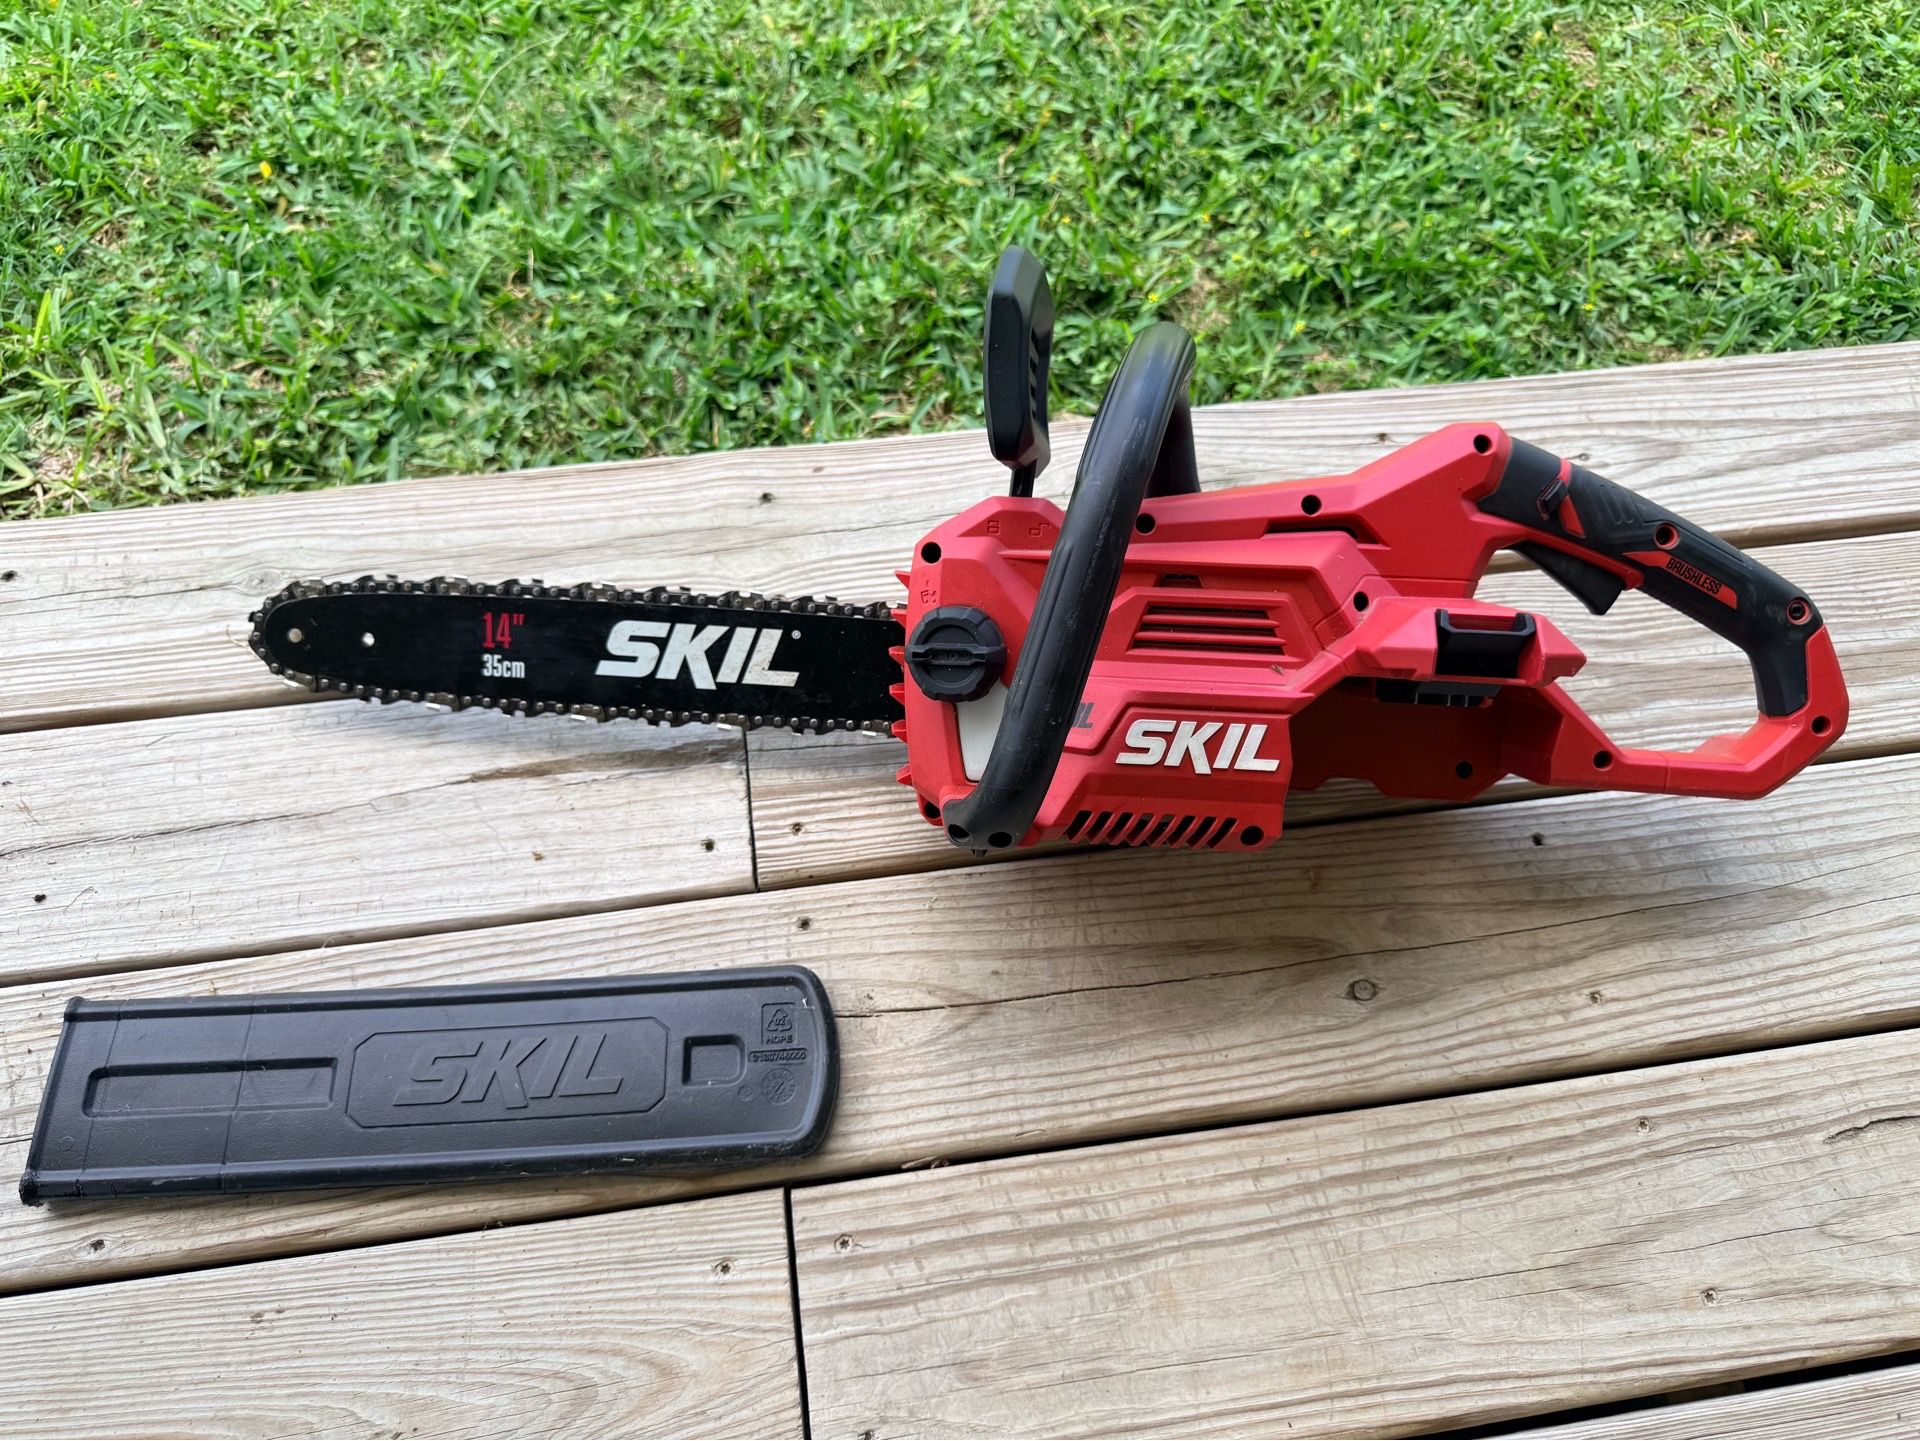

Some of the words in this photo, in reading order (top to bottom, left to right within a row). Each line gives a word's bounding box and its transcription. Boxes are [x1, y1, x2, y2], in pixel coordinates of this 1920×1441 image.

[1666, 557, 1722, 595] BRUSHLESS
[483, 612, 525, 649] 14"
[482, 653, 525, 679] 35cm
[1115, 719, 1280, 774] SKIL
[392, 1033, 624, 1111] SKIL
